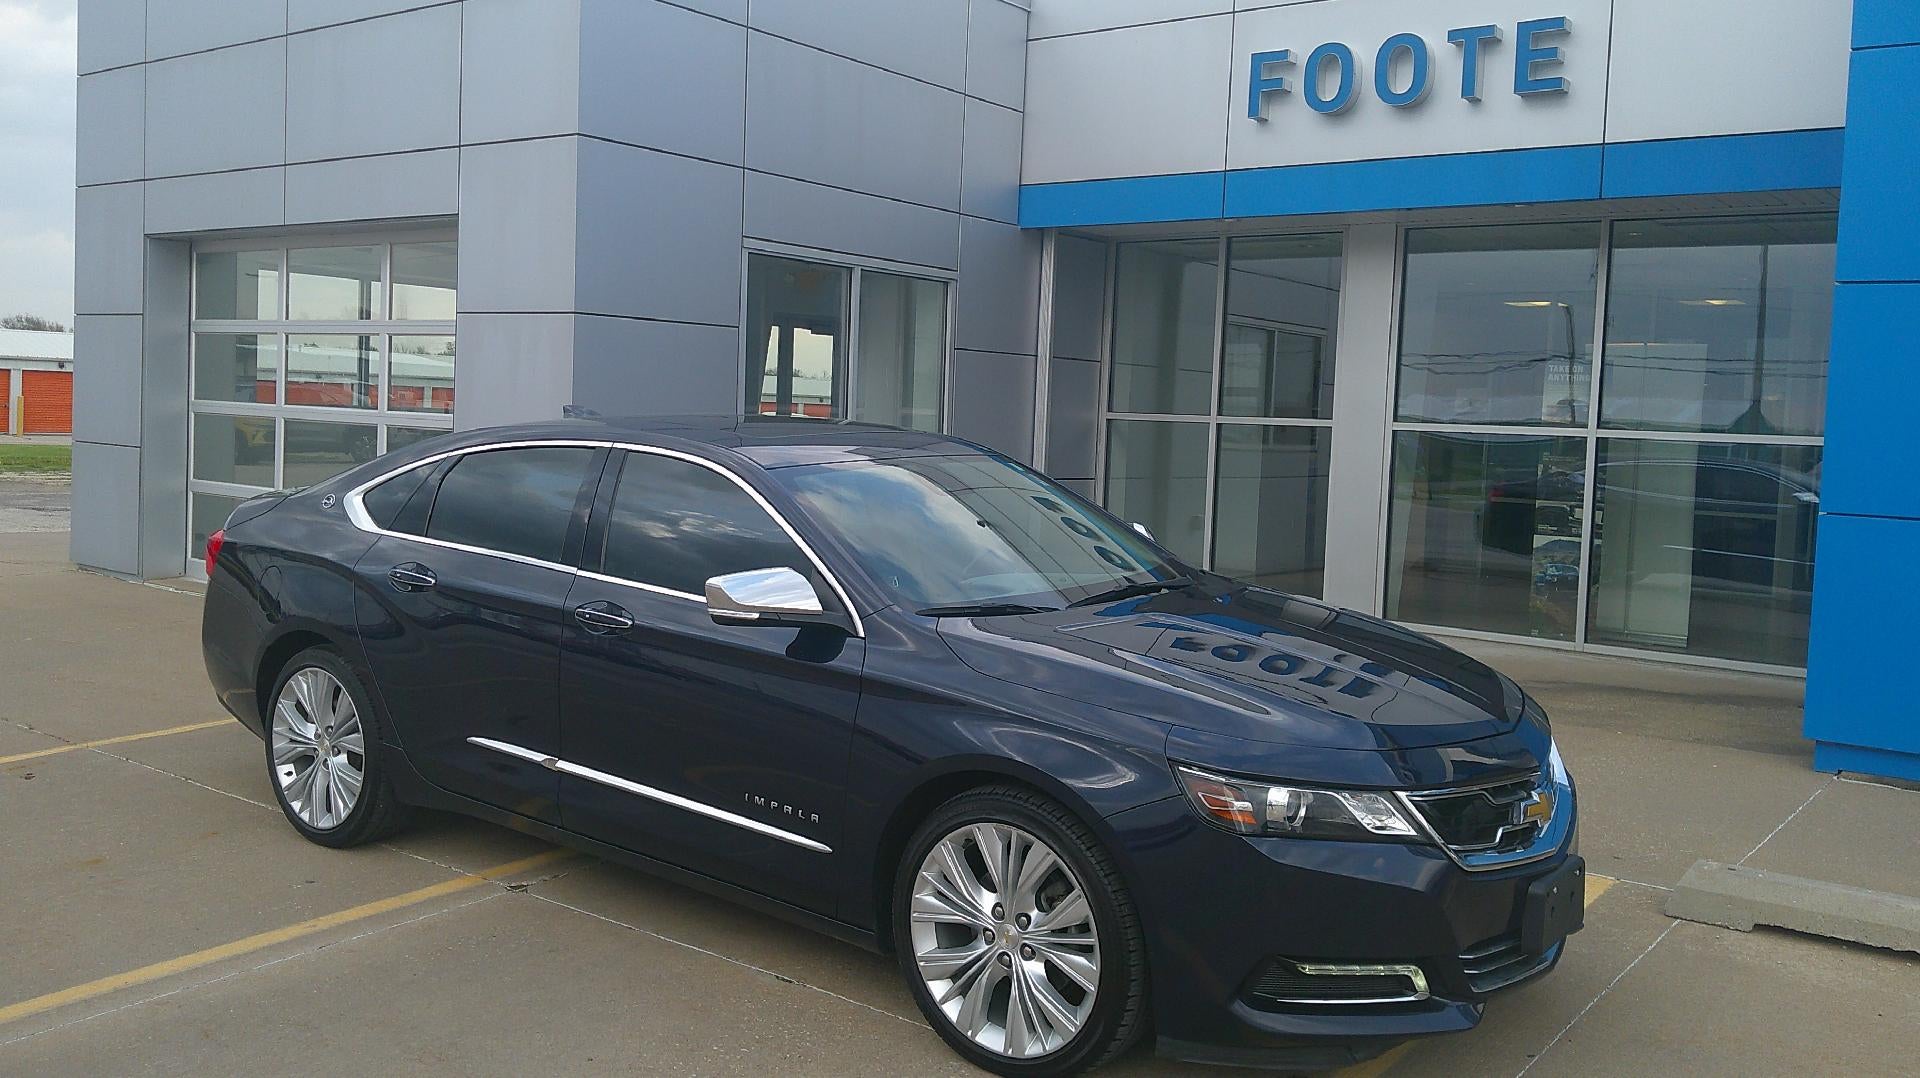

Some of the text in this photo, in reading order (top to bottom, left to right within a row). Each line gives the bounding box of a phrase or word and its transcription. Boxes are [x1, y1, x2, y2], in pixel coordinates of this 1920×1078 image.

[1248, 15, 1572, 123] FOOTE
[1548, 364, 1584, 373] TAKE ON
[744, 792, 820, 824] IMPALA
